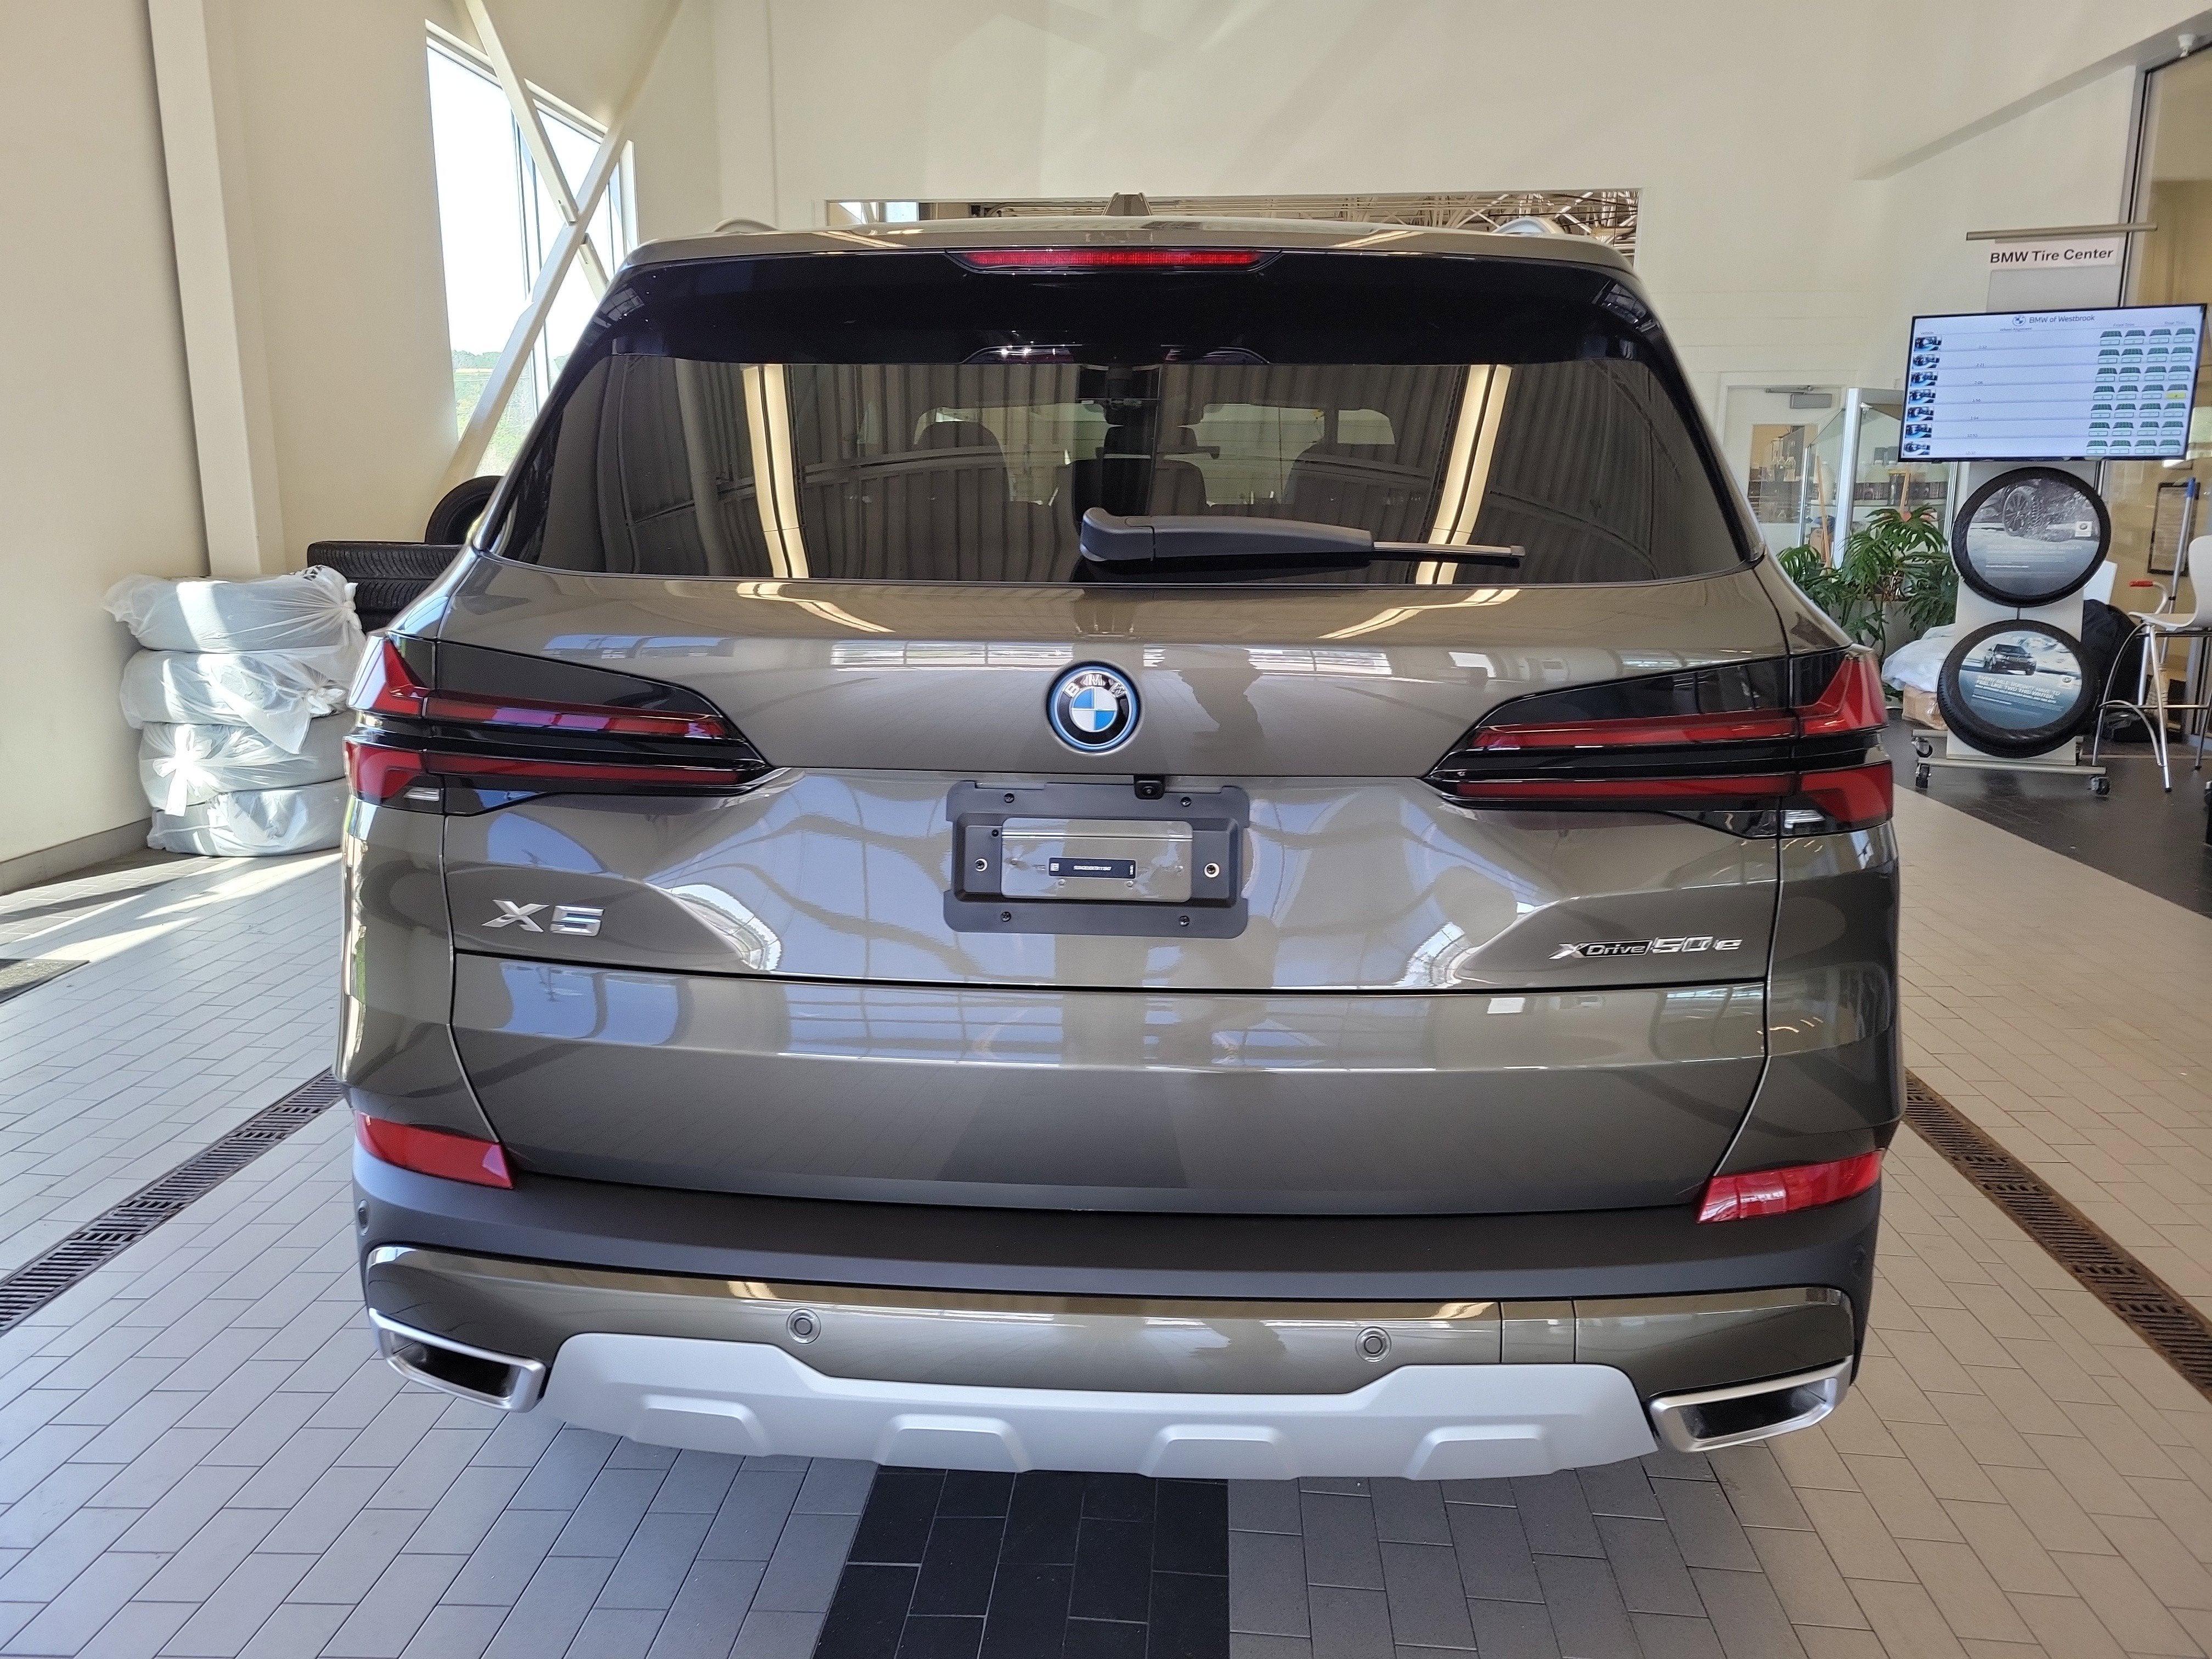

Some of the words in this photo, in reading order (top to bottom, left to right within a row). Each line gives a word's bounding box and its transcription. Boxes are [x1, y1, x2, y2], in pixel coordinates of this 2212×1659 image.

[1990, 251, 2029, 263] BMW
[2032, 250, 2059, 262] Tire
[2064, 249, 2114, 261] Center
[1064, 674, 1126, 698] BMW
[481, 899, 604, 937] X5
